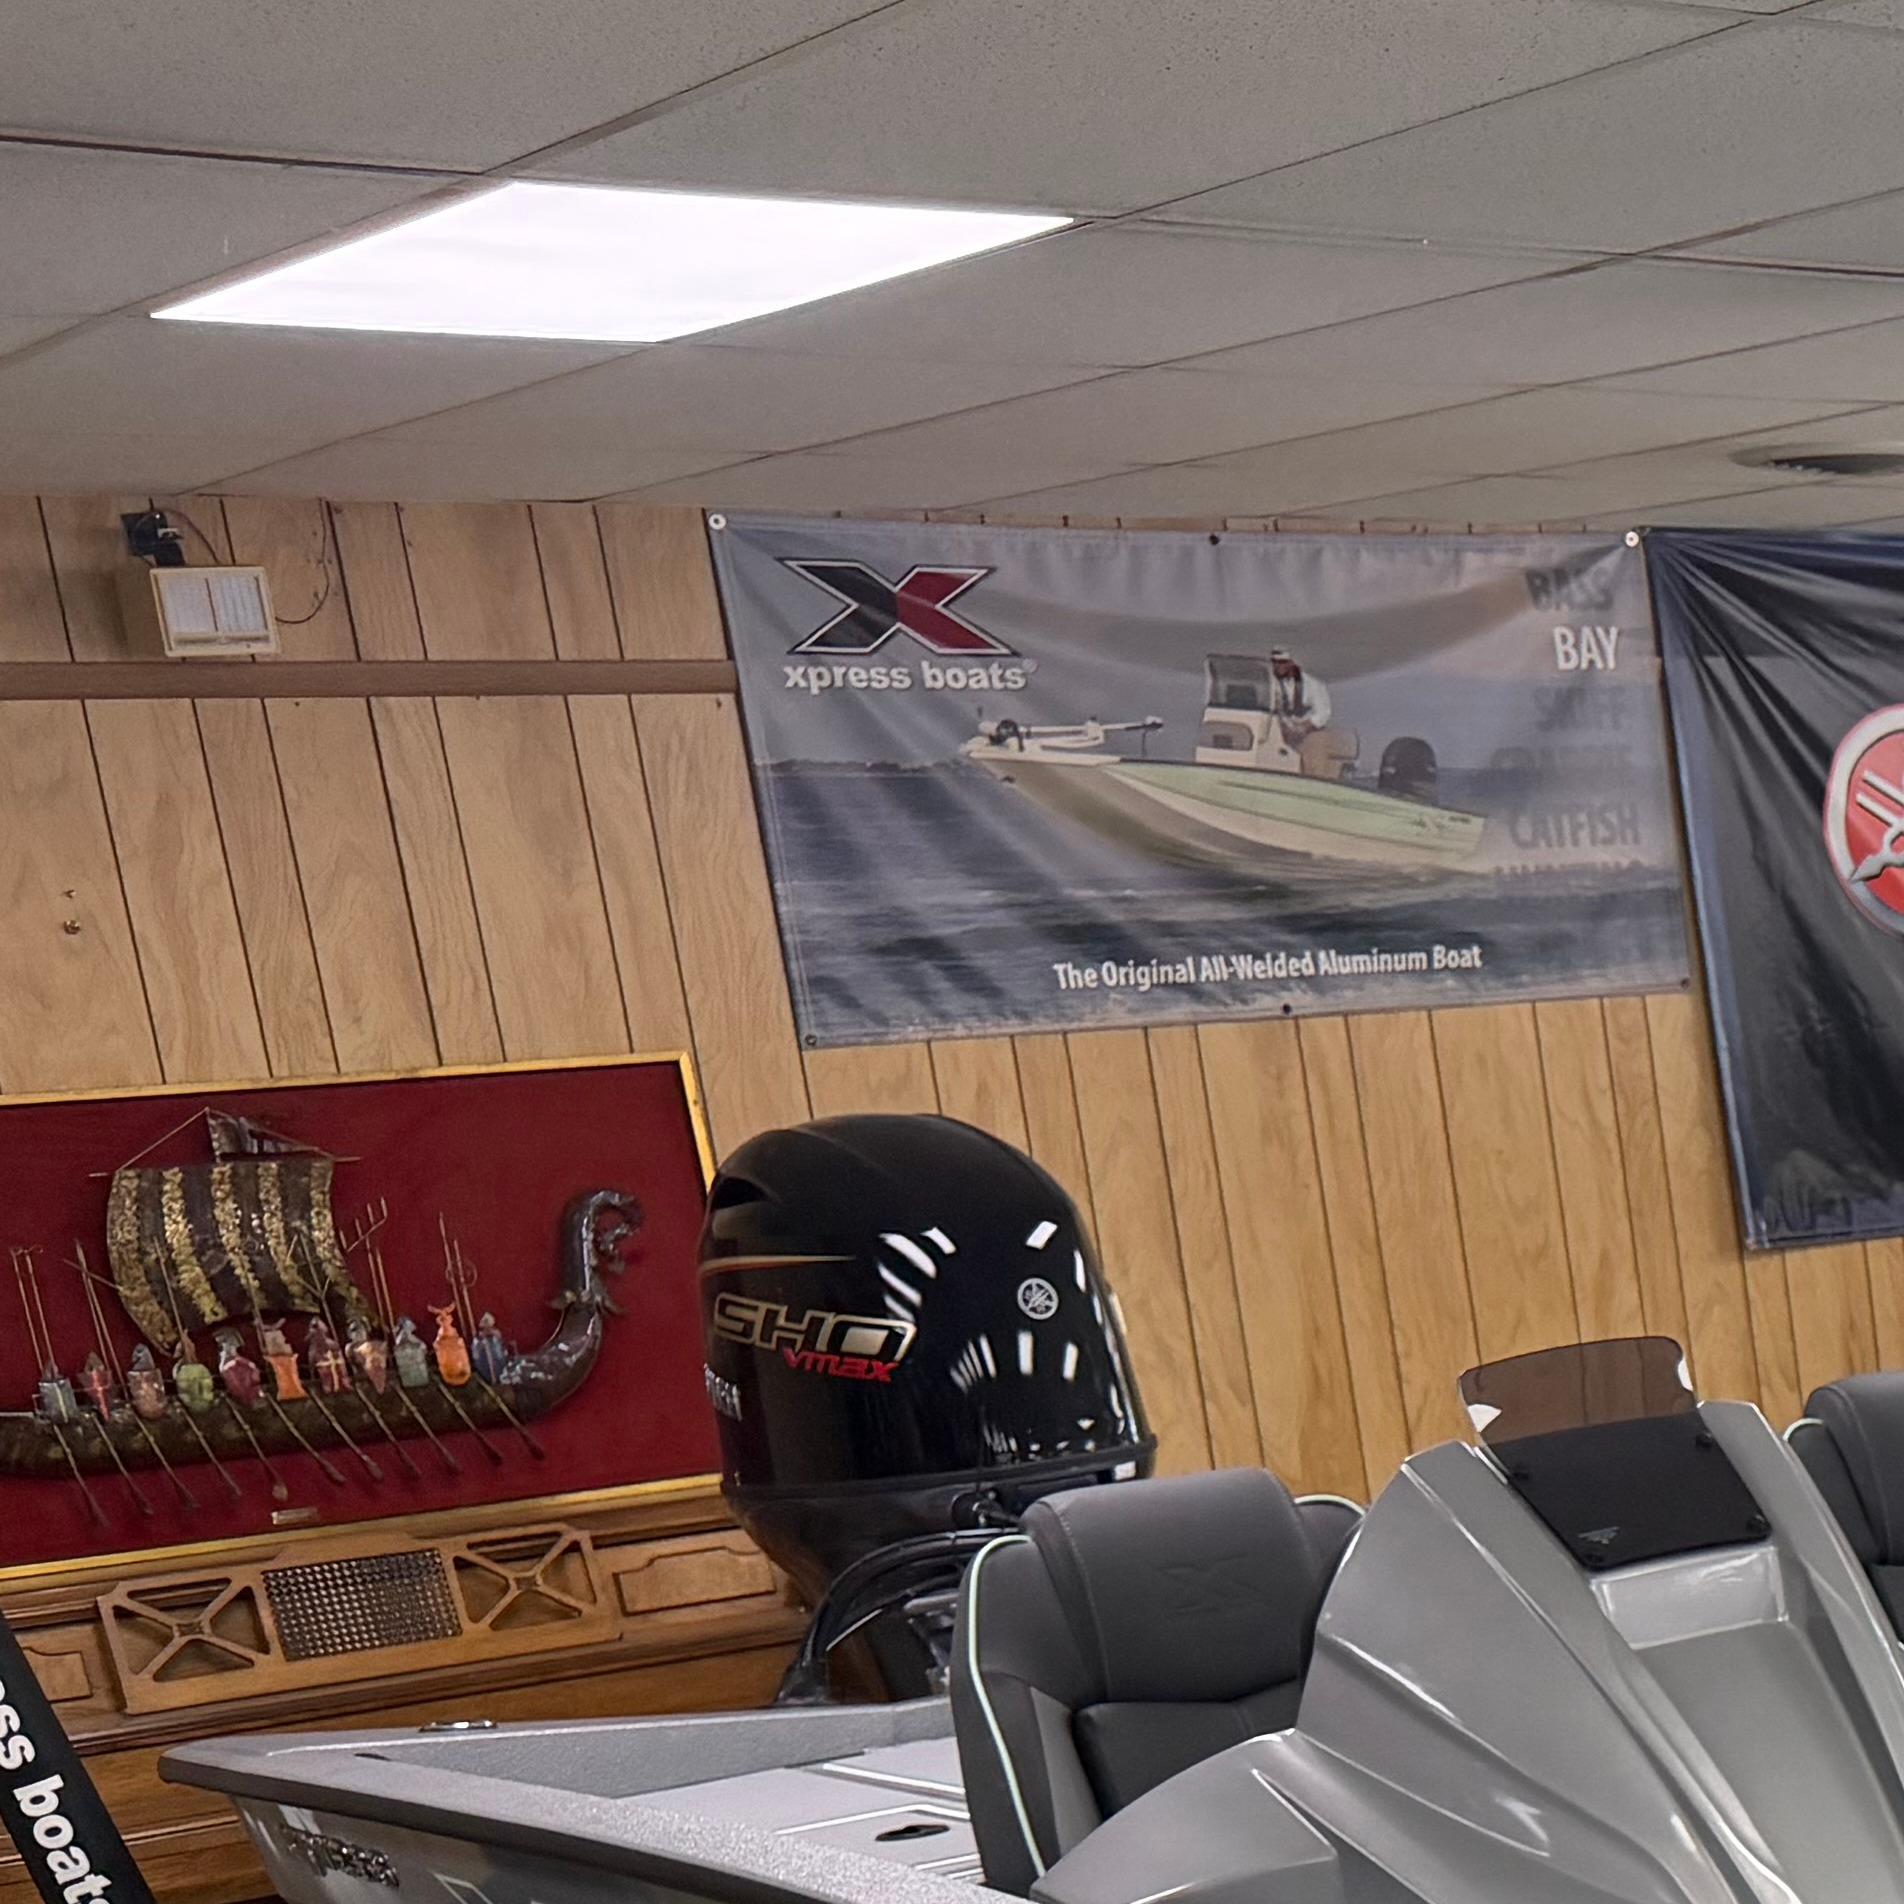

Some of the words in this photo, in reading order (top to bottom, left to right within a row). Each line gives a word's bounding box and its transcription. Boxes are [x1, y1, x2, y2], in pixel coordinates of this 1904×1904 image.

[1553, 626, 1619, 671] BAY
[784, 665, 912, 696] xpress
[1053, 962, 1098, 990] The
[1101, 957, 1196, 992] Original
[1199, 950, 1316, 983] All-Welded
[1318, 946, 1428, 976] Aluminum
[1432, 944, 1483, 970] Boat
[714, 1292, 917, 1362] SHO
